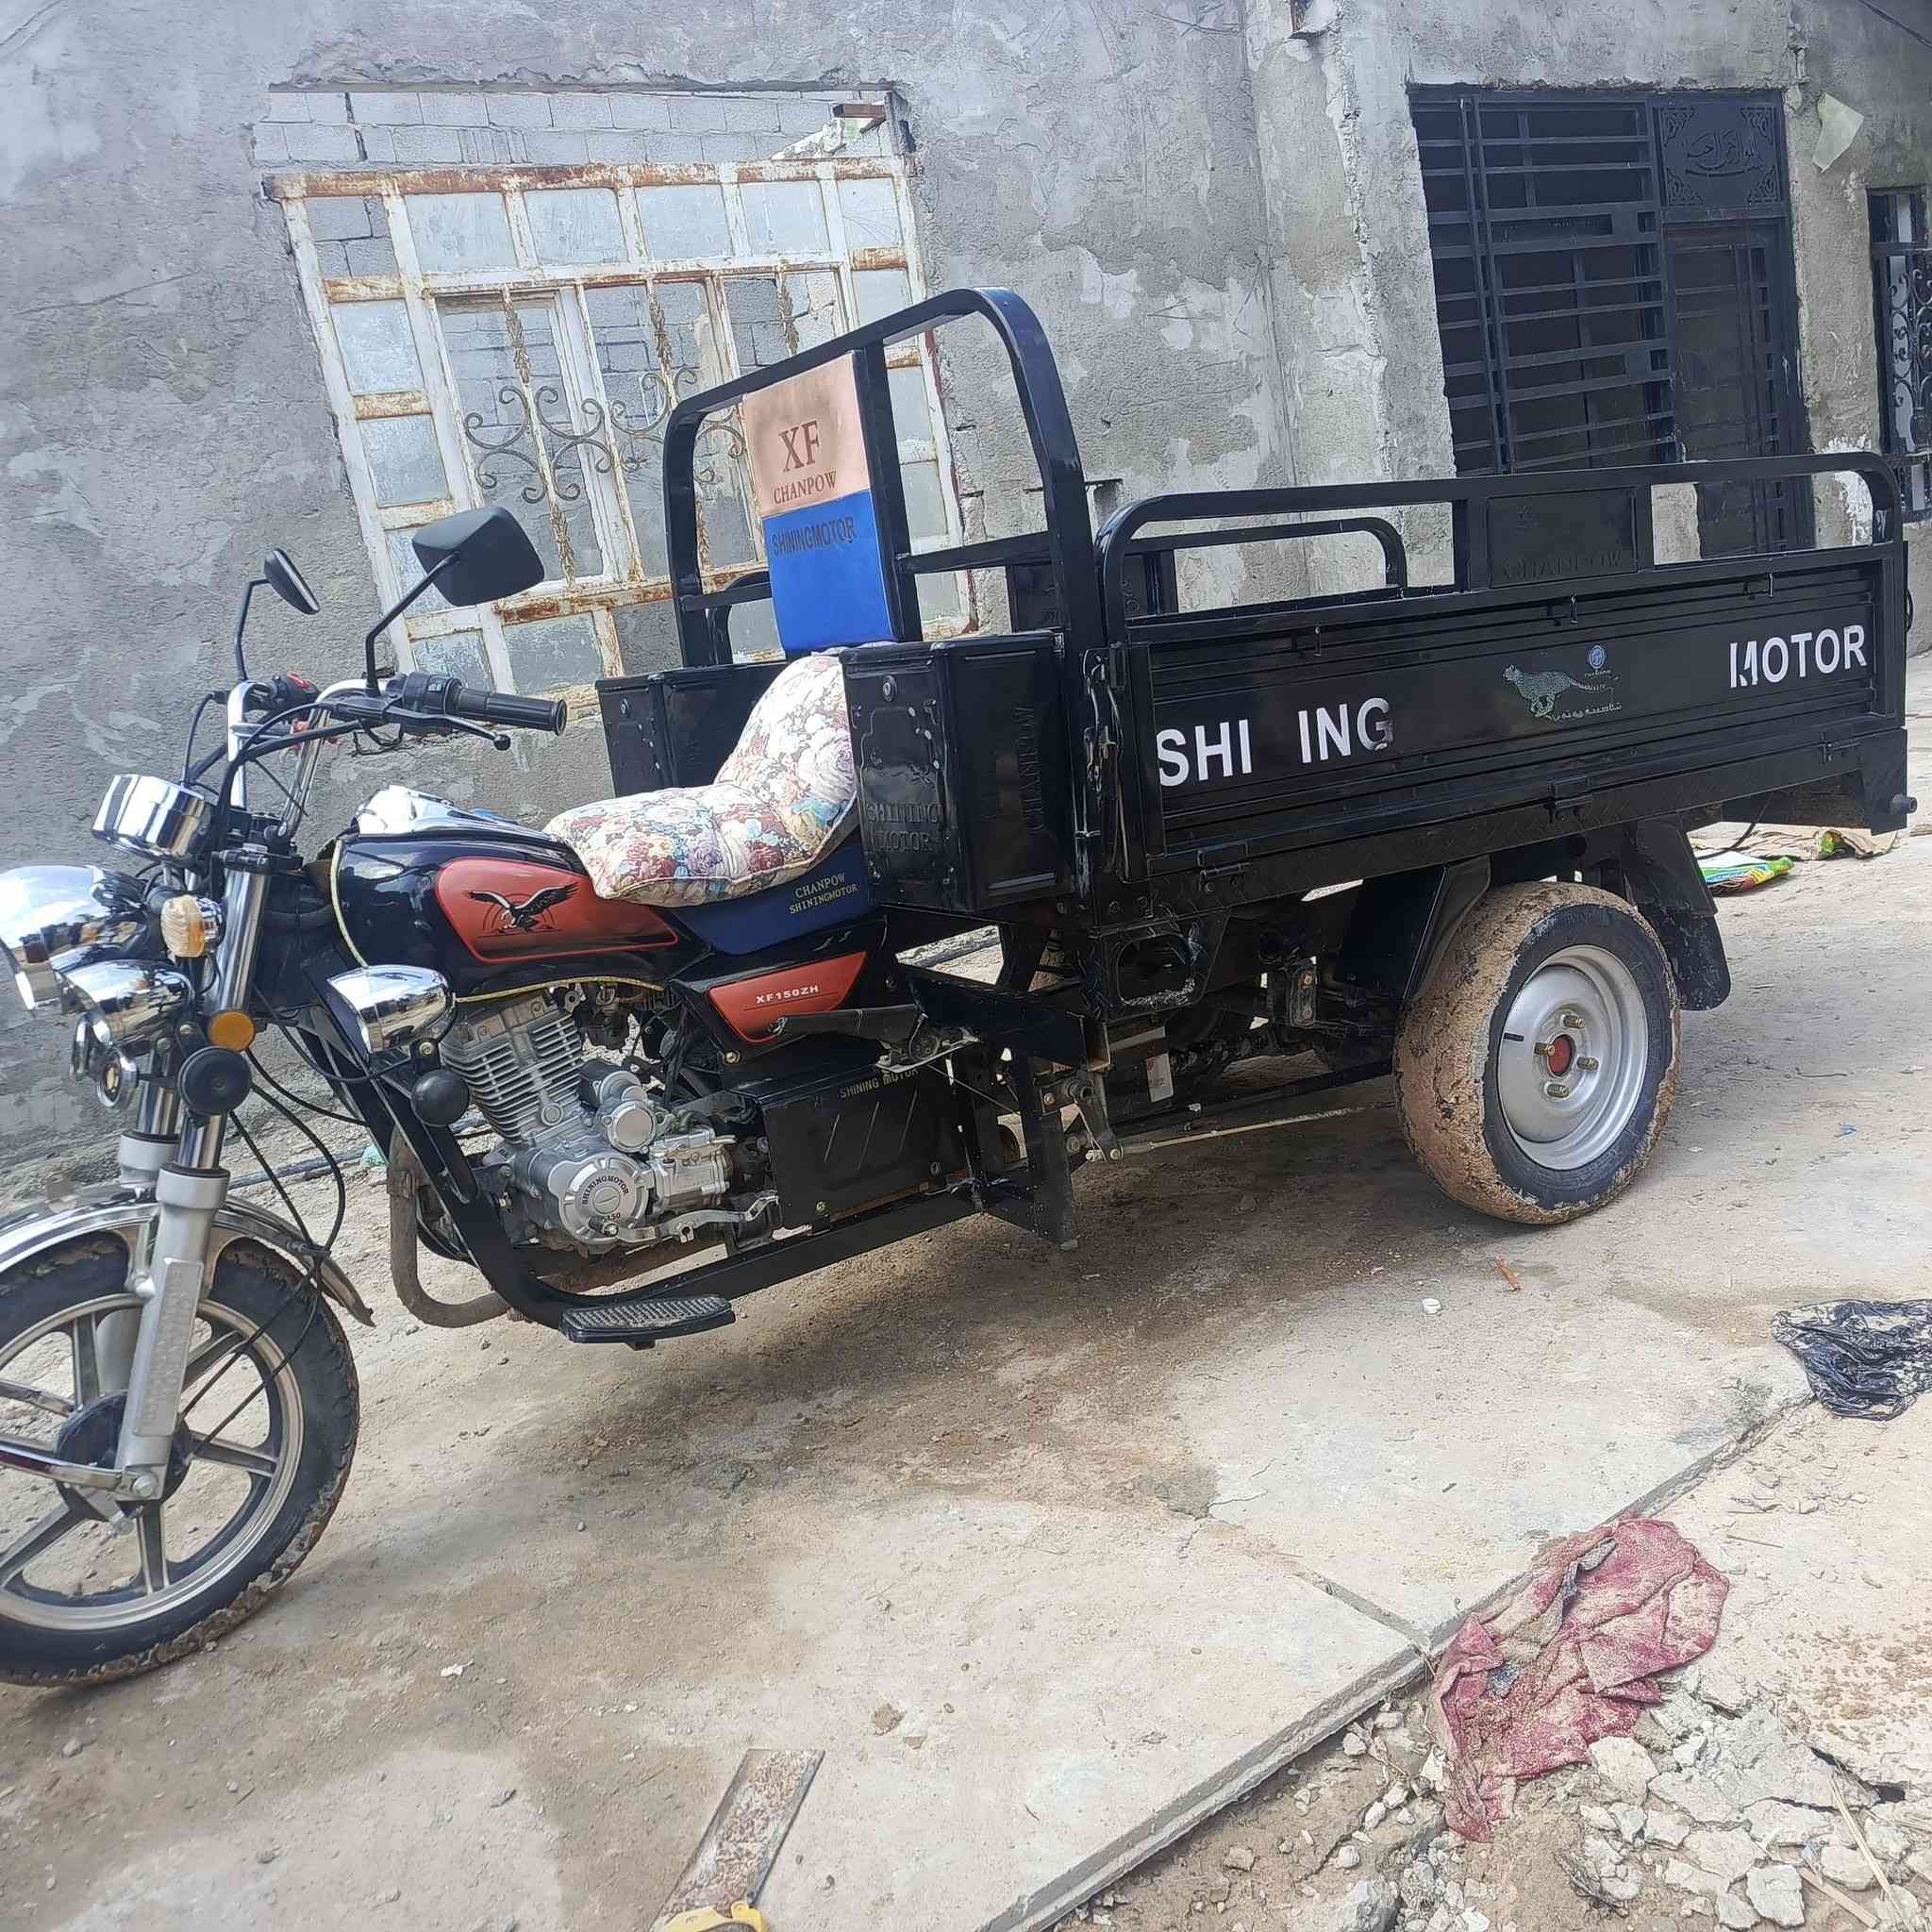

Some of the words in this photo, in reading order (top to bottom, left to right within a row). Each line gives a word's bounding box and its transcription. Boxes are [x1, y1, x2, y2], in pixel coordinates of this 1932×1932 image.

[778, 420, 819, 472] XF
[774, 471, 837, 504] CHANPOW
[772, 517, 857, 557] SHININGMOTOR
[1730, 625, 1868, 688] MOTOR
[790, 883, 858, 914] SHININGMOTOR
[795, 873, 846, 898] CHANPOW
[756, 986, 819, 1004] XF150ZH
[839, 1077, 879, 1098] SHINING
